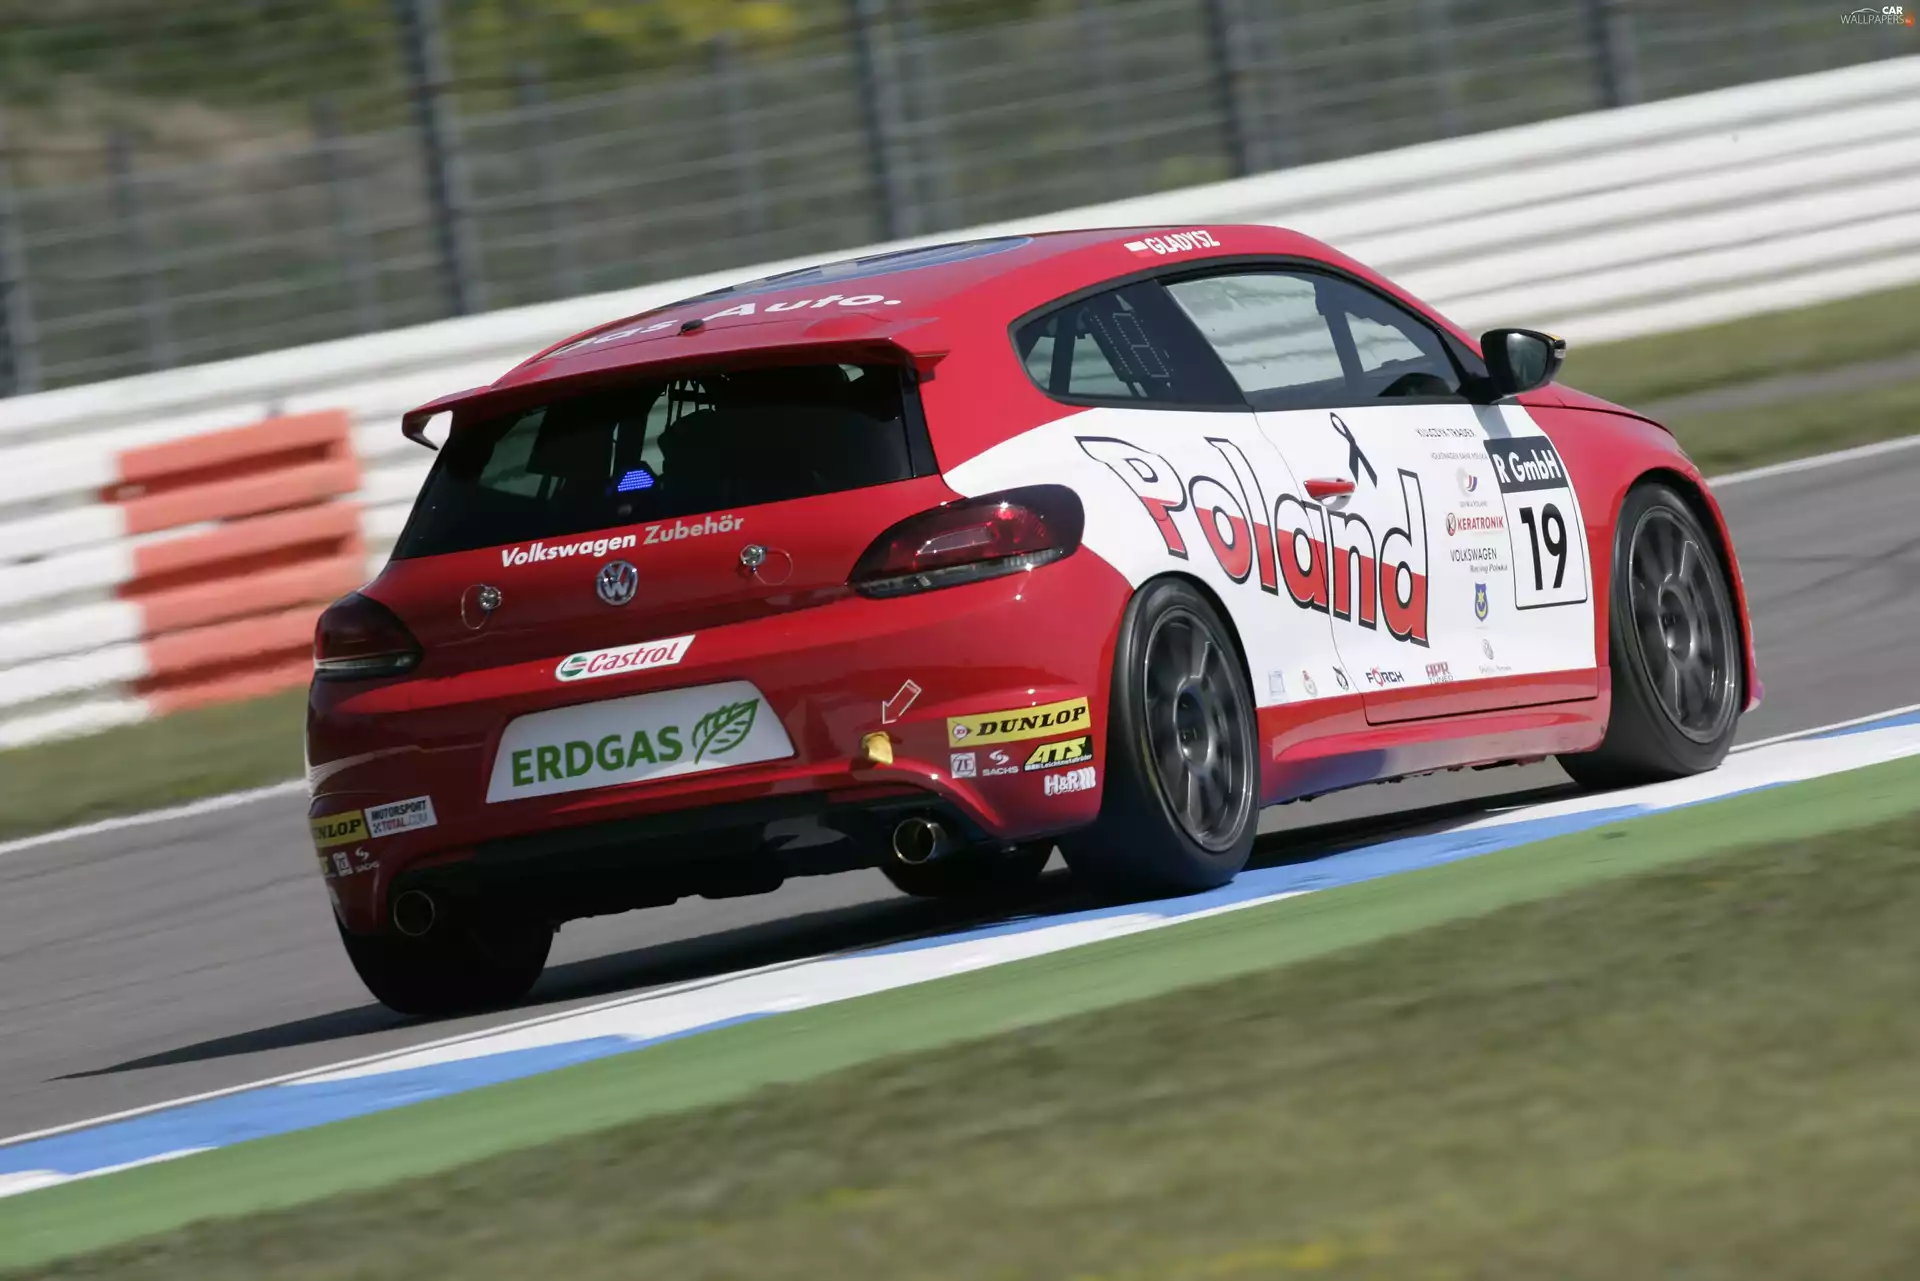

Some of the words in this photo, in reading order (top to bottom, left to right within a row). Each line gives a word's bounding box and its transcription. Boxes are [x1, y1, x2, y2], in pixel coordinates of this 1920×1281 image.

[1144, 230, 1221, 255] GLADYSZ
[701, 294, 902, 322] Auto.
[1493, 454, 1510, 483] R
[1508, 450, 1562, 482] GmbH
[1457, 517, 1504, 531] KERATRONIK
[501, 534, 637, 568] Volkswagen
[643, 514, 744, 546] Zubehör
[1074, 436, 1430, 648] Poland
[1450, 548, 1498, 562] VOLKSWAGEN
[1519, 502, 1567, 591] 19
[587, 642, 680, 674] Castrol
[976, 706, 1086, 737] DUNLOP
[511, 726, 683, 787] ERDGAS
[1025, 736, 1087, 765] ATS
[982, 765, 1019, 776] SACHS
[1044, 770, 1083, 796] H&R
[371, 801, 426, 821] MOTORSPORT
